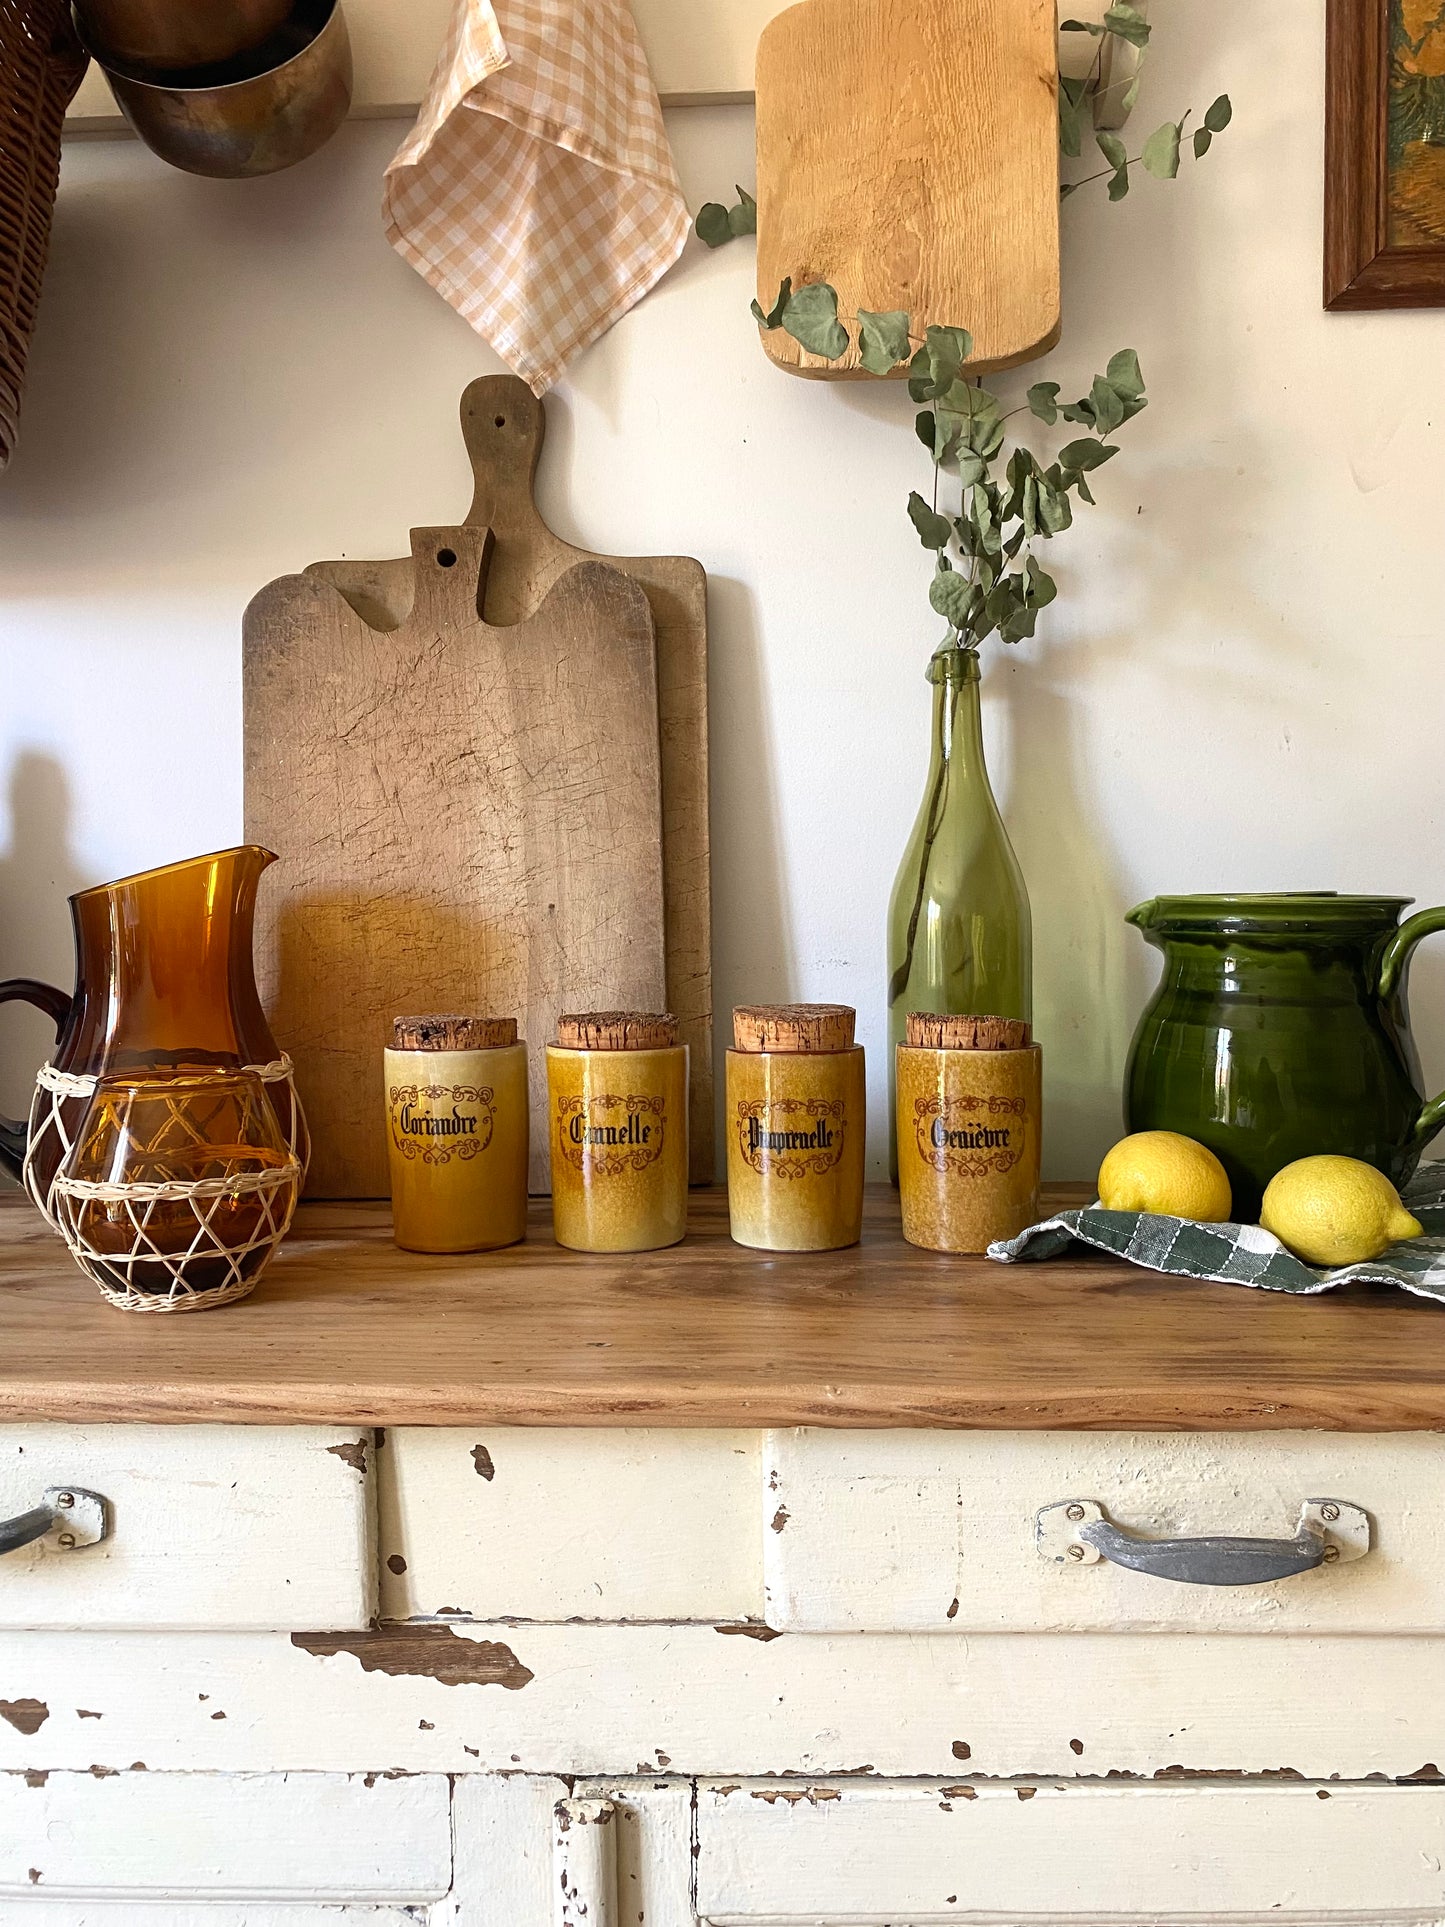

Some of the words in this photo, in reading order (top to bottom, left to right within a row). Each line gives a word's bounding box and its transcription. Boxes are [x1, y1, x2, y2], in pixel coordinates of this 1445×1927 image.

[401, 1102, 477, 1136] Coriandre
[748, 1116, 833, 1154] Pimprenelle
[931, 1116, 1009, 1149] Genièvre
